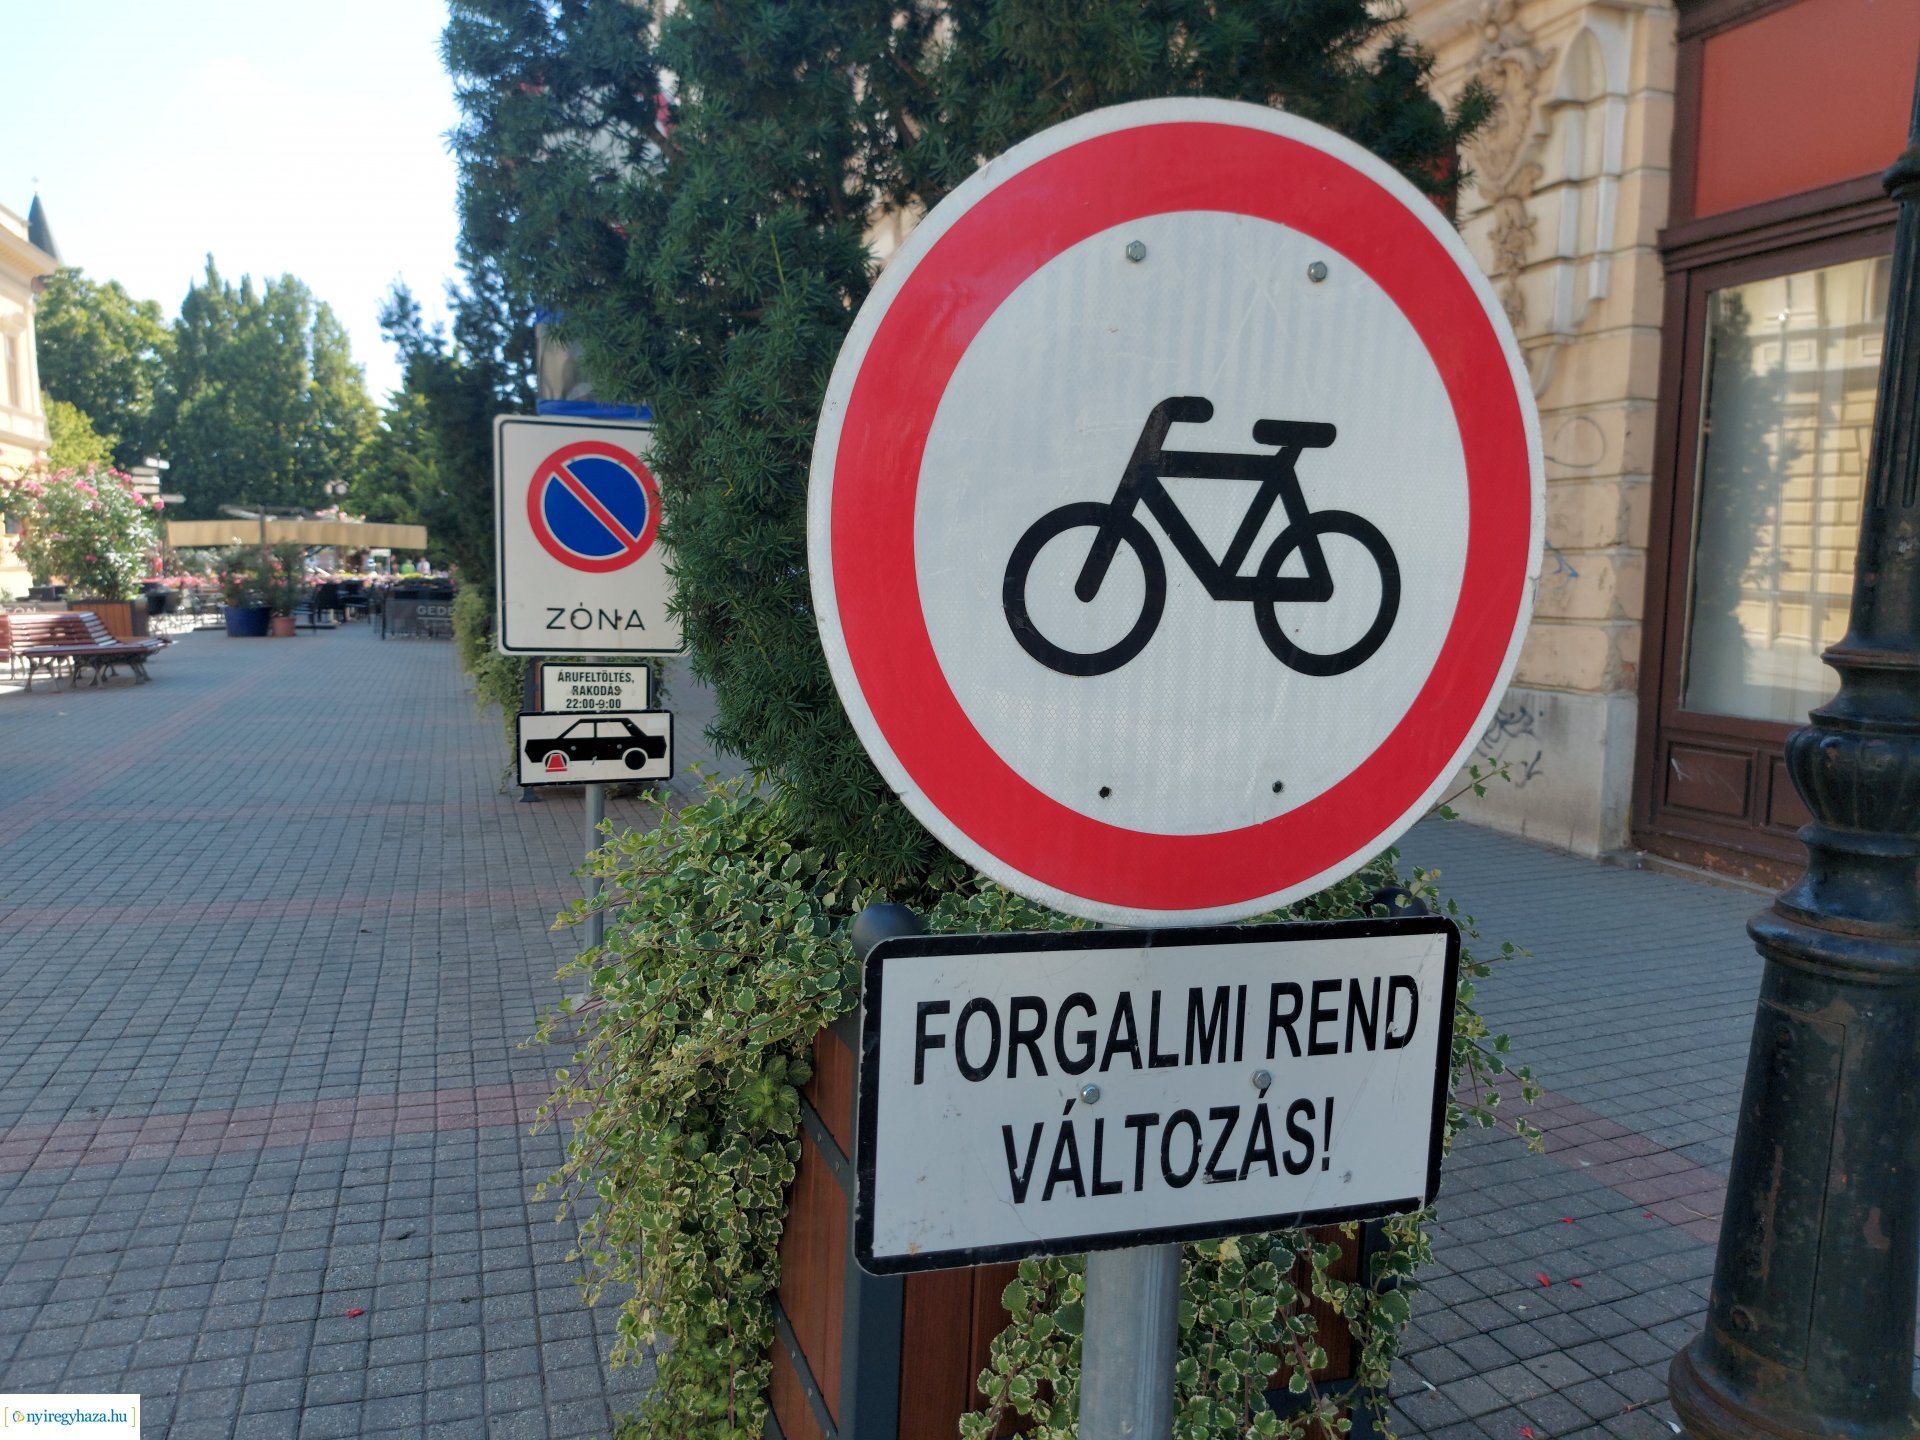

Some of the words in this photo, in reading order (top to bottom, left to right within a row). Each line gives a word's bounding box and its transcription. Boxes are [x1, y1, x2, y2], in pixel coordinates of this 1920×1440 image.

[546, 602, 646, 631] ZÓNA
[557, 669, 635, 684] ÁRUFELTÖLTÉS,
[572, 683, 621, 696] RAKODÁS
[566, 698, 622, 709] 22:00-9:00
[913, 982, 1246, 1086] FORGALMI
[1266, 974, 1420, 1061] REND
[1001, 1083, 1335, 1204] VÁLTOZÁS!
